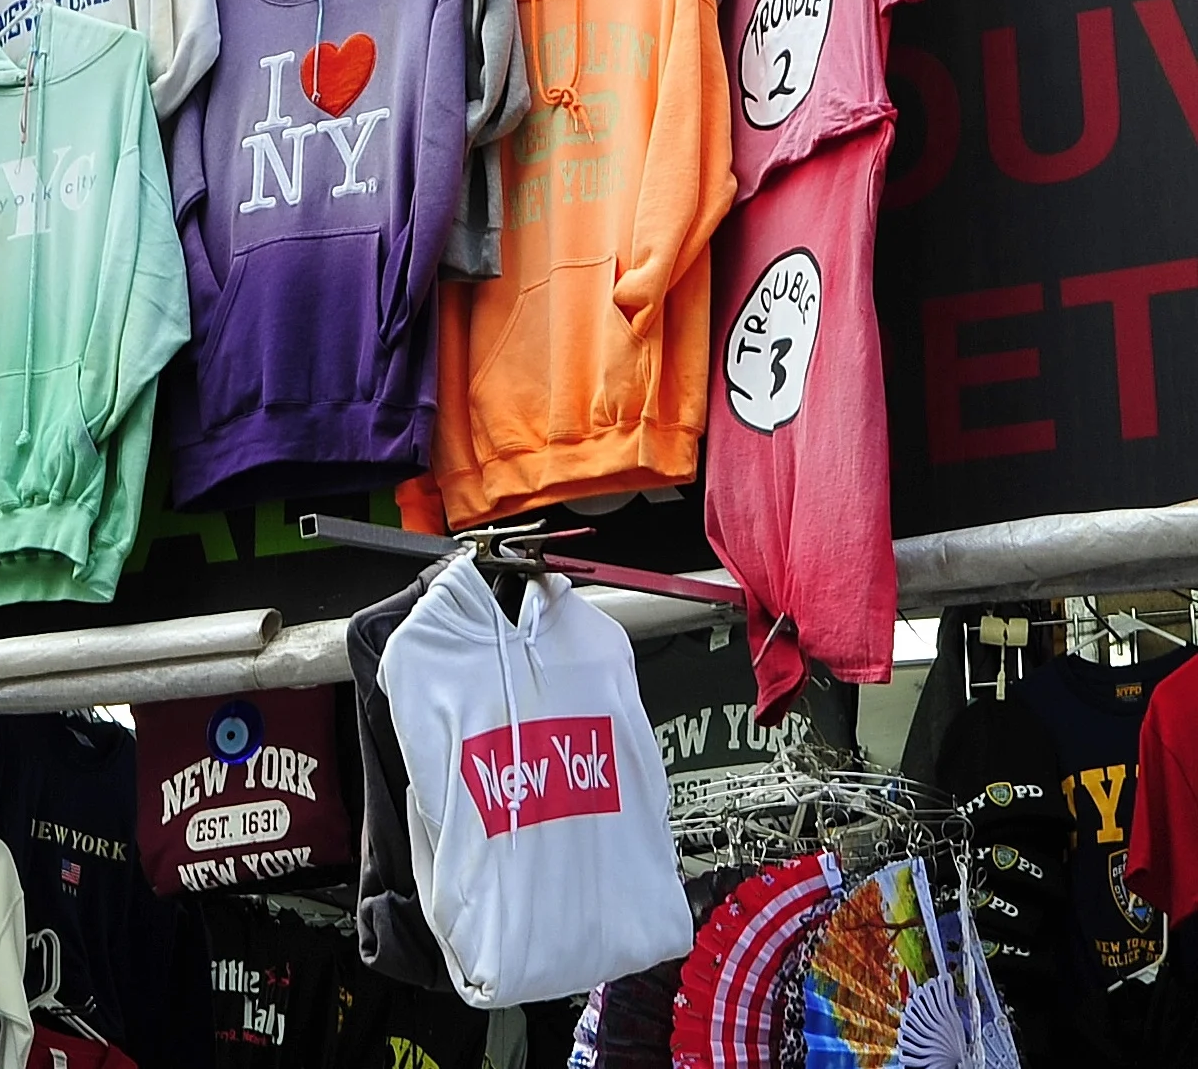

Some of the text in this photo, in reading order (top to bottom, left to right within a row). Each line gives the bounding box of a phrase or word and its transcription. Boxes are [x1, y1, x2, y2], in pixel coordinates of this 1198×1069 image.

[255, 50, 295, 132] I
[768, 48, 796, 101] 2
[736, 269, 816, 365] TROUBLE
[769, 337, 793, 400] 3
[653, 707, 712, 768] EW
[161, 746, 319, 826] NEW YORK
[471, 748, 550, 812] New
[1013, 784, 1044, 799] PD
[71, 829, 129, 863] YORK
[195, 808, 280, 843] EST. 1631
[178, 857, 239, 892] NEW
[976, 846, 1044, 879] Y PD
[988, 895, 1019, 918] PD
